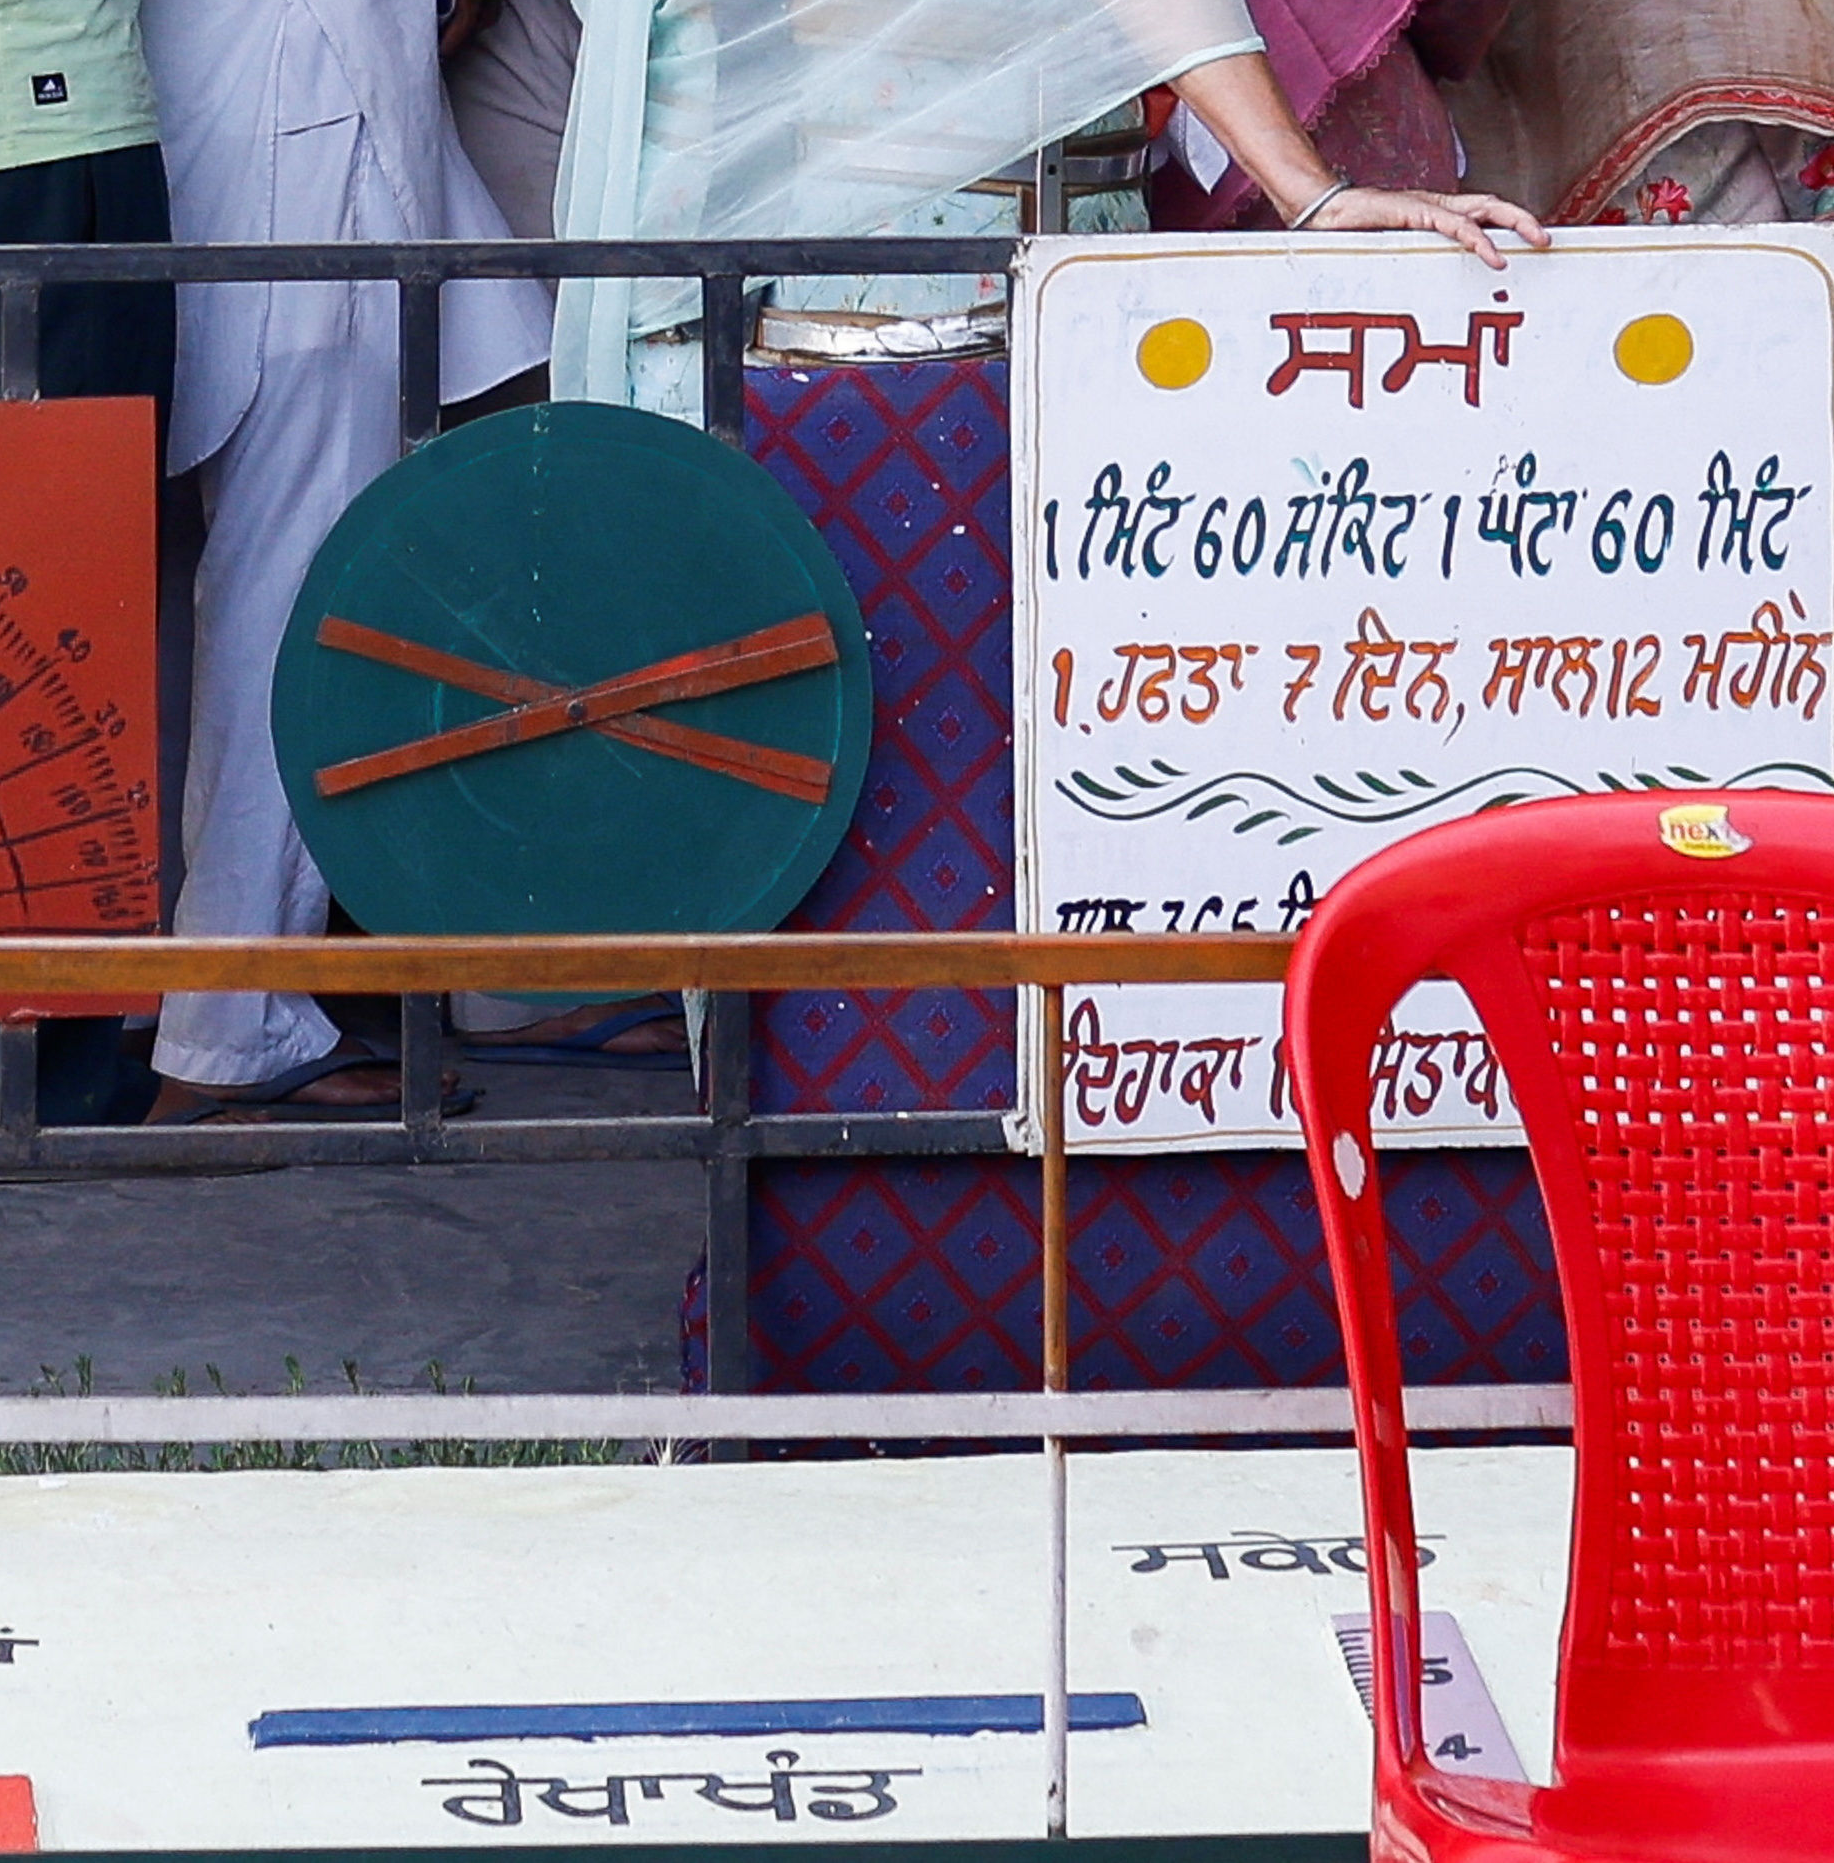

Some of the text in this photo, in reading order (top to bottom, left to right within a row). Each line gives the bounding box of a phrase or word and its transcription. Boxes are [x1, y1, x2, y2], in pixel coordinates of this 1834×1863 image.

[1266, 288, 1526, 410] ਸਮਾਂ
[1078, 459, 1196, 581] ਮਿੰਟ
[1193, 494, 1268, 579] 60
[1591, 487, 1677, 576] 60
[1696, 449, 1815, 576] ਮਿੰਟ
[1282, 643, 1323, 722] 7
[1479, 636, 1607, 722] ਸਾਲ
[1604, 632, 1664, 721] 12
[421, 1746, 924, 1828] ਰੇਖਾਖੰਡ
